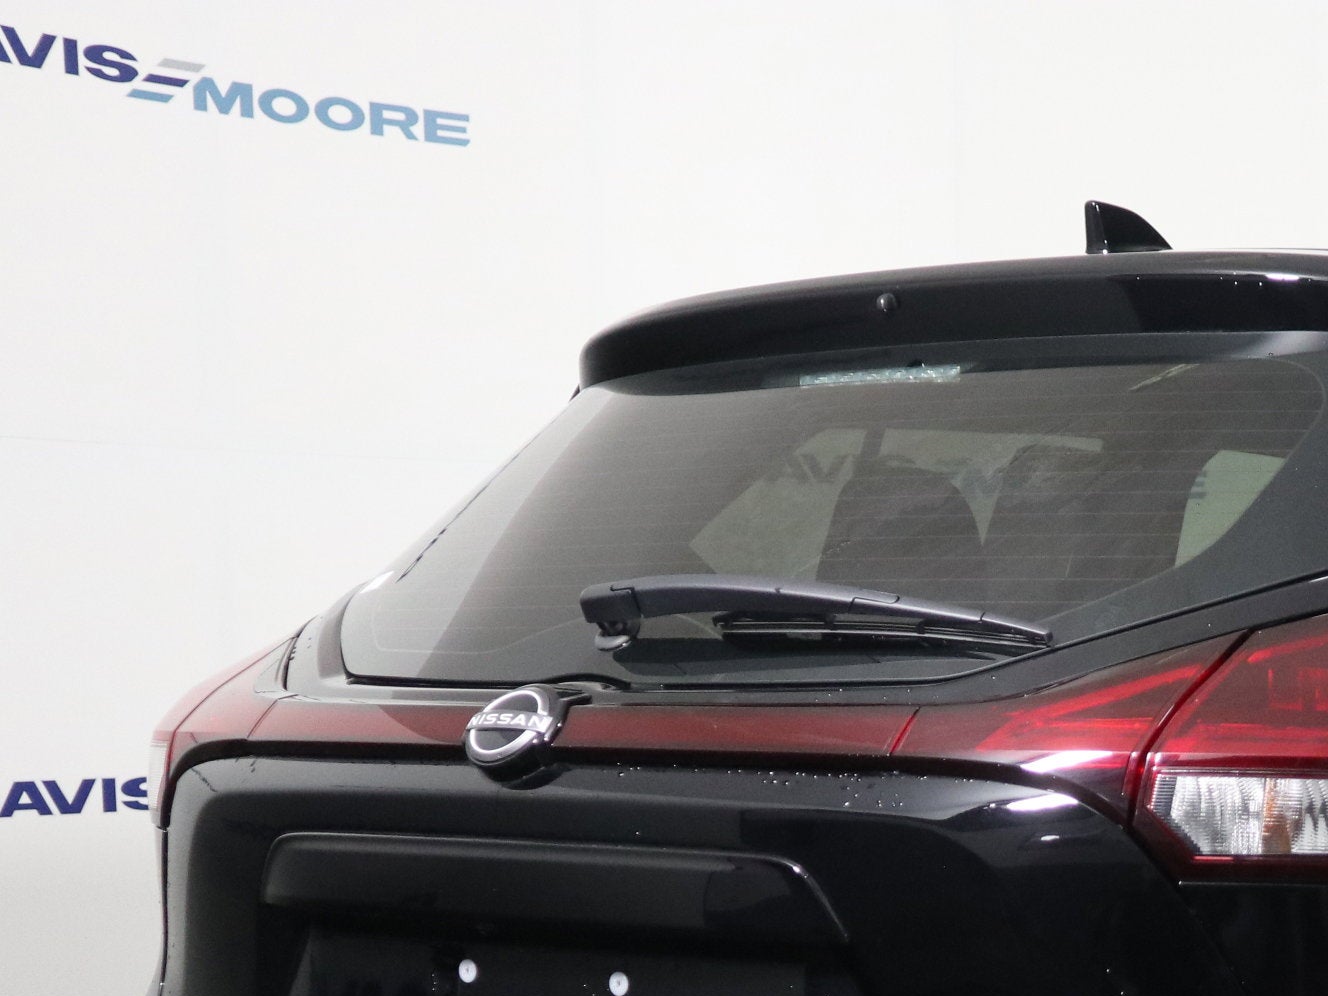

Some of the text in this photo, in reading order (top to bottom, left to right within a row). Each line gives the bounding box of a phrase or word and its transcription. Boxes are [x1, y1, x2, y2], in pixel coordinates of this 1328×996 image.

[0, 24, 470, 147] VIS MOORE
[466, 712, 553, 733] NISSAN
